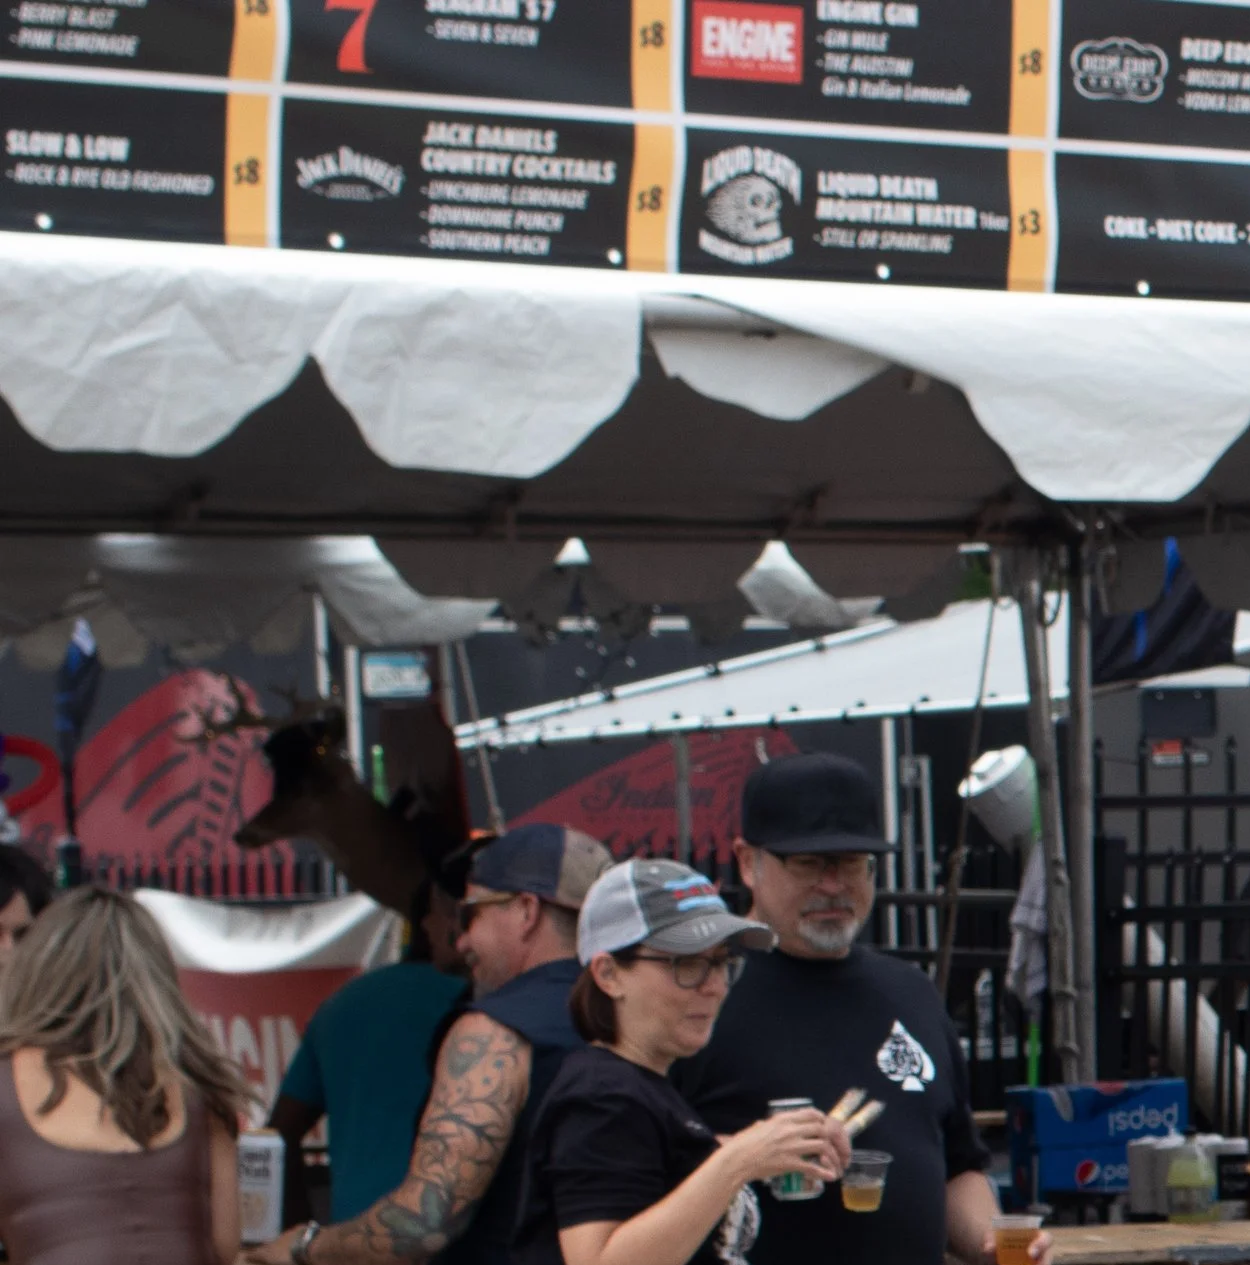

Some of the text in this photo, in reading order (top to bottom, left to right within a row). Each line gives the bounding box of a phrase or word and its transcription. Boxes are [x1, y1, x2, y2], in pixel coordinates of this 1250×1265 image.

[817, 0, 919, 27] ENGINE GIN
[55, 31, 140, 57] LEMONADE
[324, 0, 373, 74] 7
[492, 25, 539, 46] SEVEN
[639, 21, 664, 48] $8
[701, 17, 797, 61] ENGINE
[851, 30, 890, 52] MULE
[1018, 48, 1043, 75] $8
[1180, 37, 1223, 62] DEEP
[821, 77, 845, 97] Gin
[904, 83, 971, 105] Lemonade
[6, 129, 130, 162] SLOW & LOW
[422, 121, 558, 154] JACK DANIELS
[56, 164, 69, 187] &
[71, 165, 100, 188] RYE
[100, 168, 132, 191] OLD
[132, 170, 215, 197] FASHIONED
[233, 156, 261, 186] $8
[296, 151, 339, 189] JACK
[420, 148, 617, 185] COUNTRY COCKTAILS
[701, 145, 802, 206] LIQUID DEATH
[510, 185, 589, 210] LEMONADE
[636, 183, 663, 212] $8
[817, 171, 938, 200] LIQUID DEATH
[514, 209, 565, 233] PUNCH
[815, 198, 914, 226] MOUNTAIN
[915, 203, 977, 230] WATER
[1017, 209, 1042, 237] $3
[503, 233, 551, 256] PEACH
[879, 231, 953, 255] SPARKLING
[1104, 215, 1148, 239] COKE
[1156, 219, 1193, 242] DIET
[1194, 221, 1237, 245] COKE
[580, 770, 716, 814] Indin
